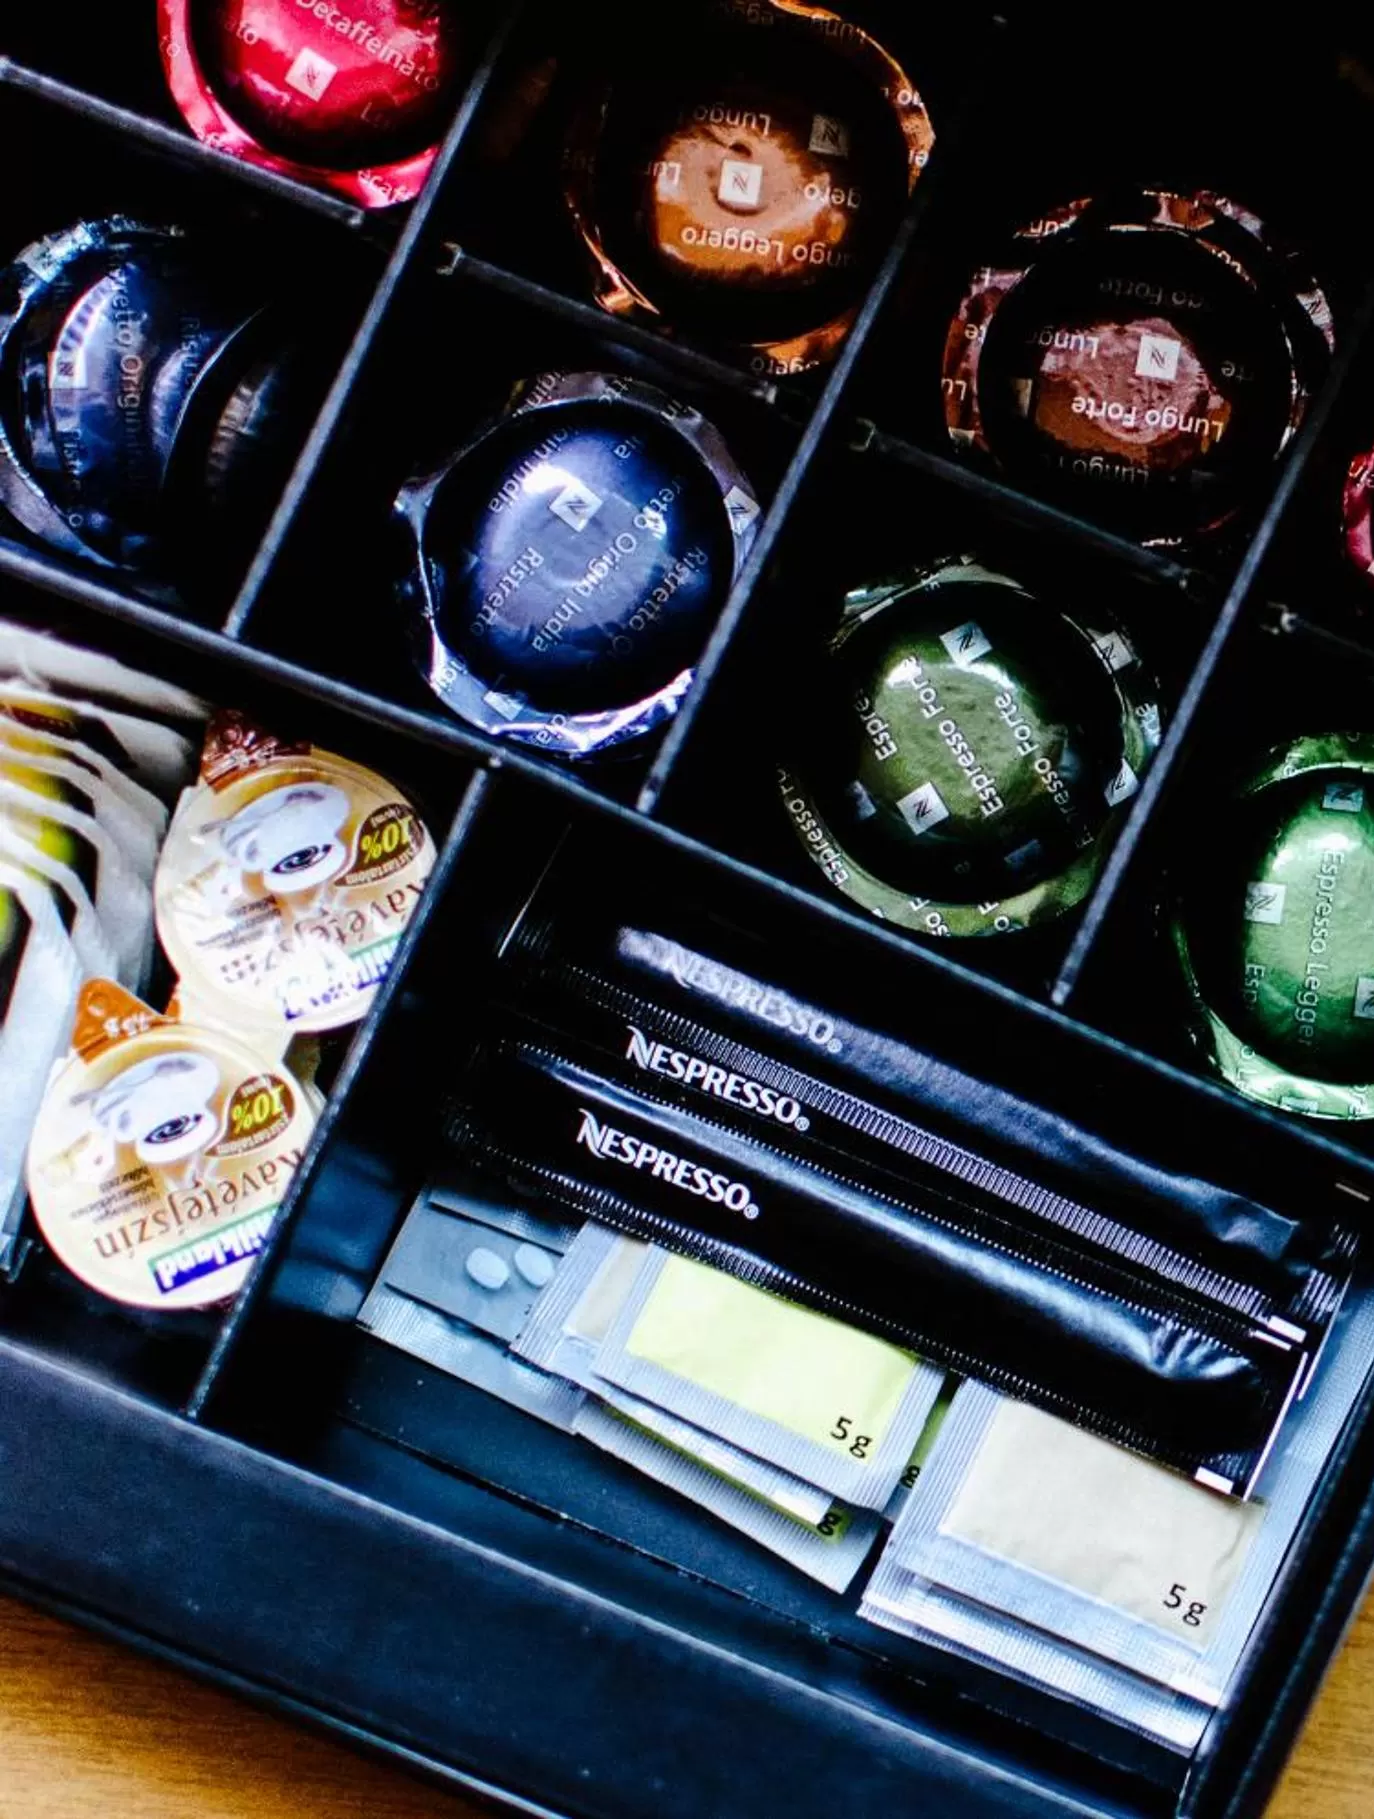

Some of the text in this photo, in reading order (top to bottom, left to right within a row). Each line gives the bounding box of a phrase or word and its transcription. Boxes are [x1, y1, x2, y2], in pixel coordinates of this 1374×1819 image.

[680, 226, 786, 266] Leggero
[1071, 395, 1226, 443] Lungo Forte
[576, 532, 637, 599] Origin
[530, 595, 582, 654] India
[993, 690, 1040, 757] Forte
[938, 718, 1005, 819] Espresso
[361, 815, 413, 863] 10%
[785, 797, 851, 888] Espresso
[1294, 847, 1346, 1047] Espresso Legger
[231, 1085, 286, 1134] 10%
